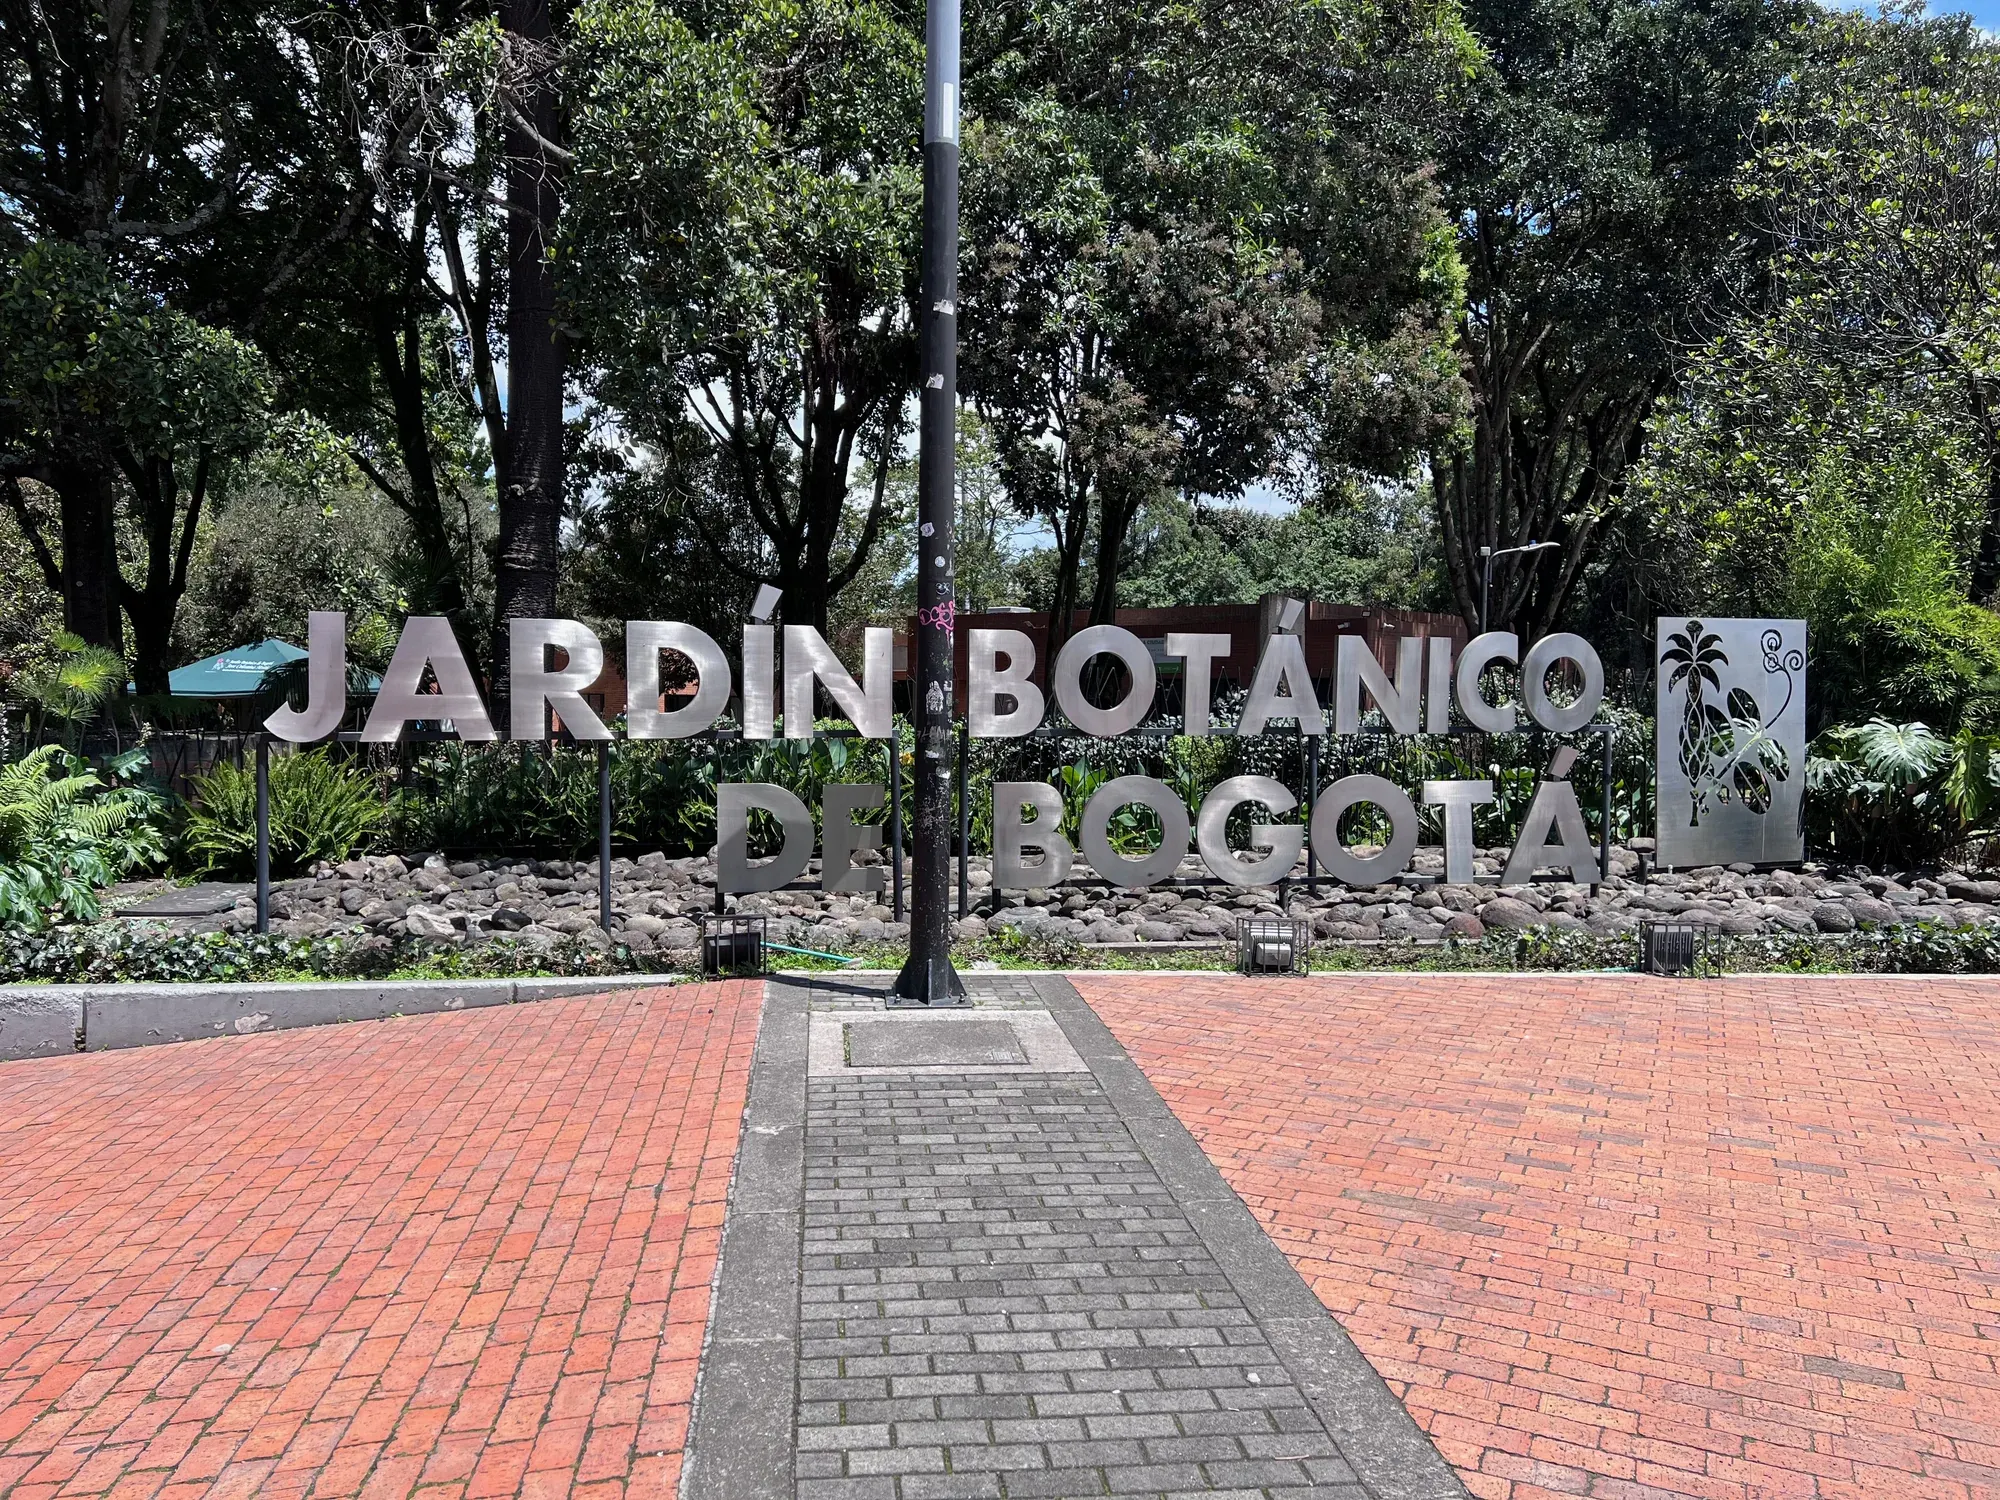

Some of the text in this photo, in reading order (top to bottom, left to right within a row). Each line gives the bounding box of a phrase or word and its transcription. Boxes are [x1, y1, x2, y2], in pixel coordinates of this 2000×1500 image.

[263, 583, 1605, 743] JARDÍN BOTÁNICO
[716, 744, 1600, 893] DE BOGOTÁ
